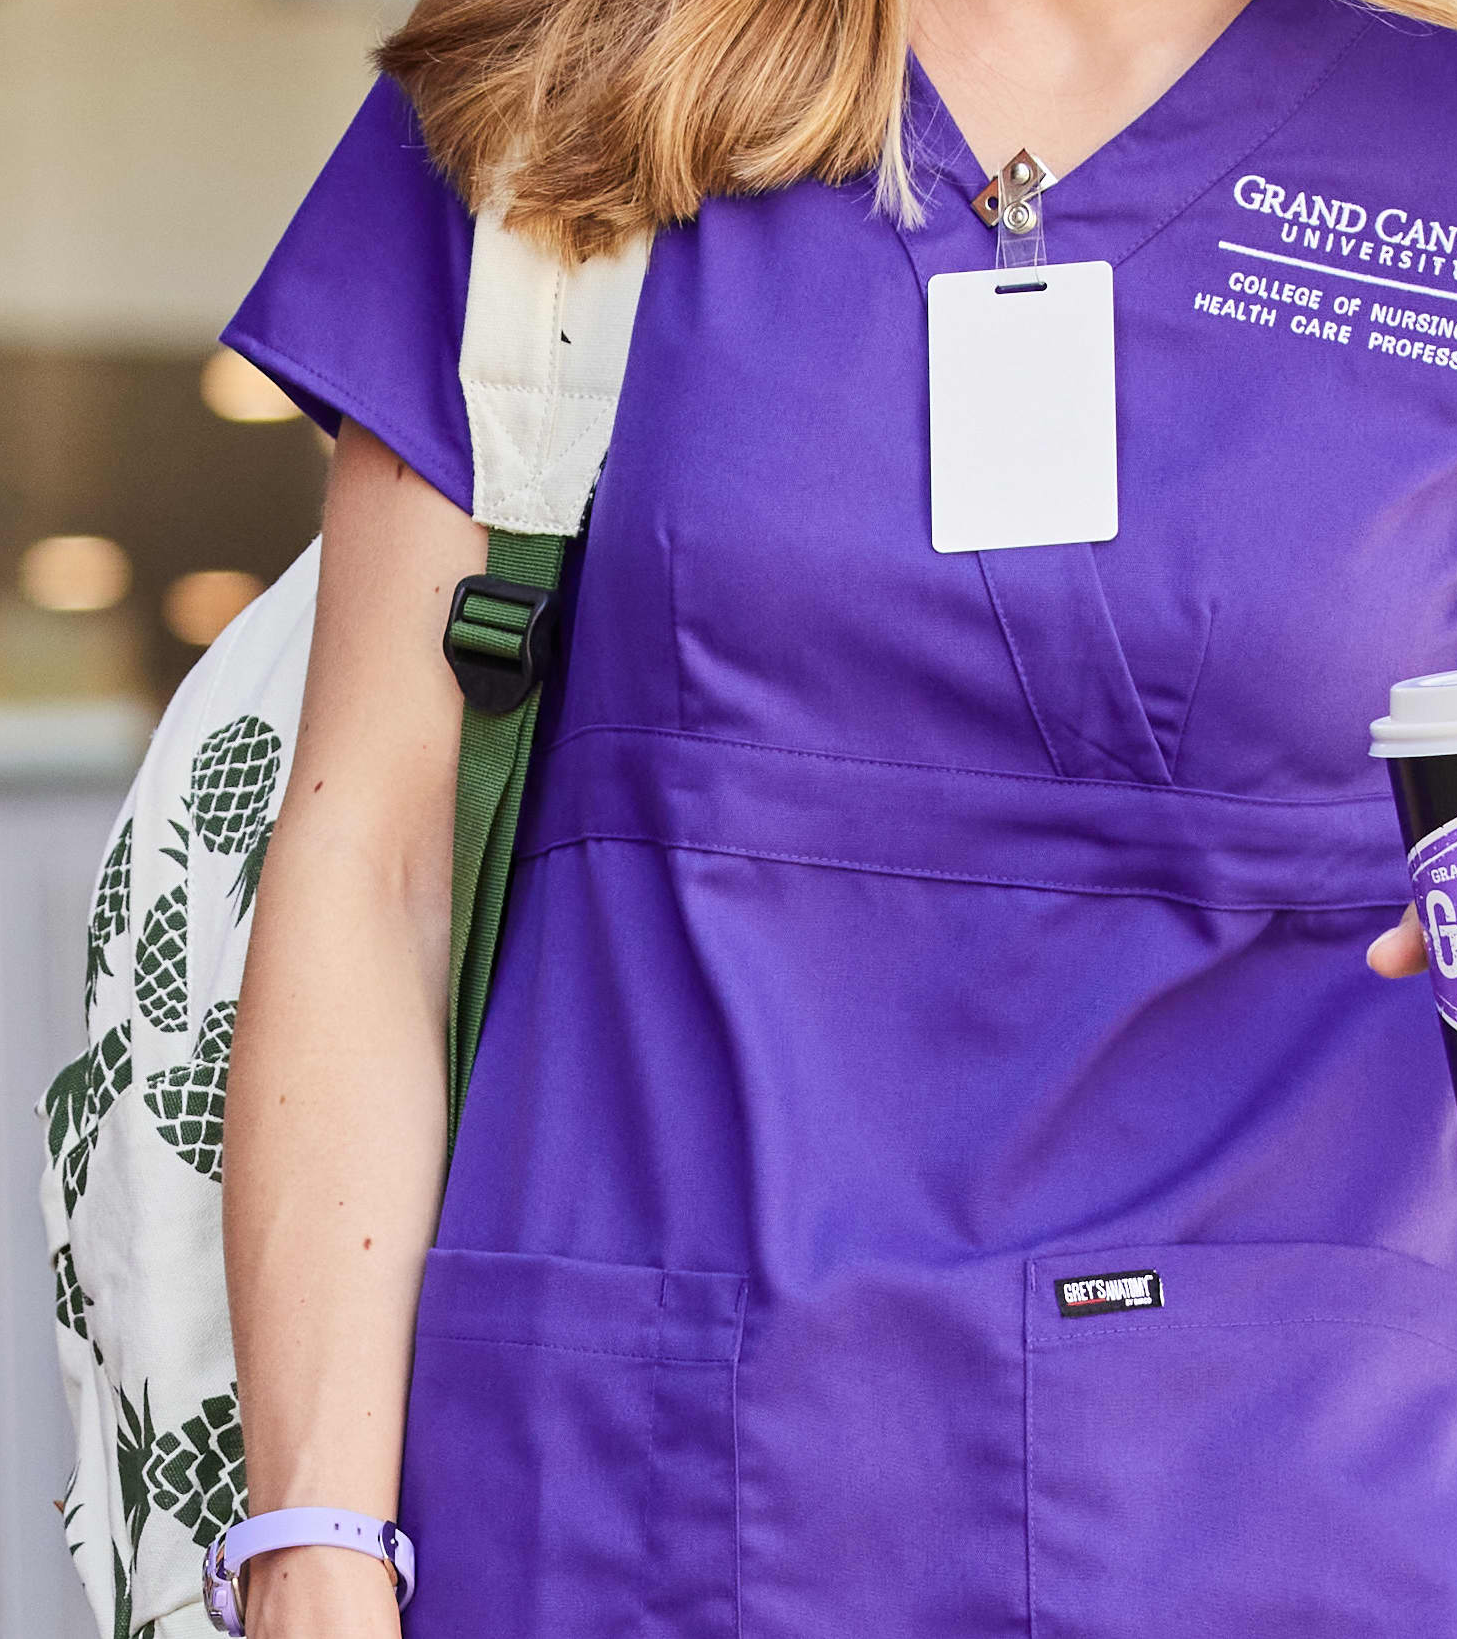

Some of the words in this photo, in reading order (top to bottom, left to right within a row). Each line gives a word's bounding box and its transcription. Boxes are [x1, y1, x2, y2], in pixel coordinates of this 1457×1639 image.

[1234, 175, 1366, 233] GRAND
[1194, 293, 1276, 327] HEALTH
[1291, 316, 1351, 344] CARE
[1229, 273, 1323, 309] COLLEGE
[1334, 297, 1361, 316] OF
